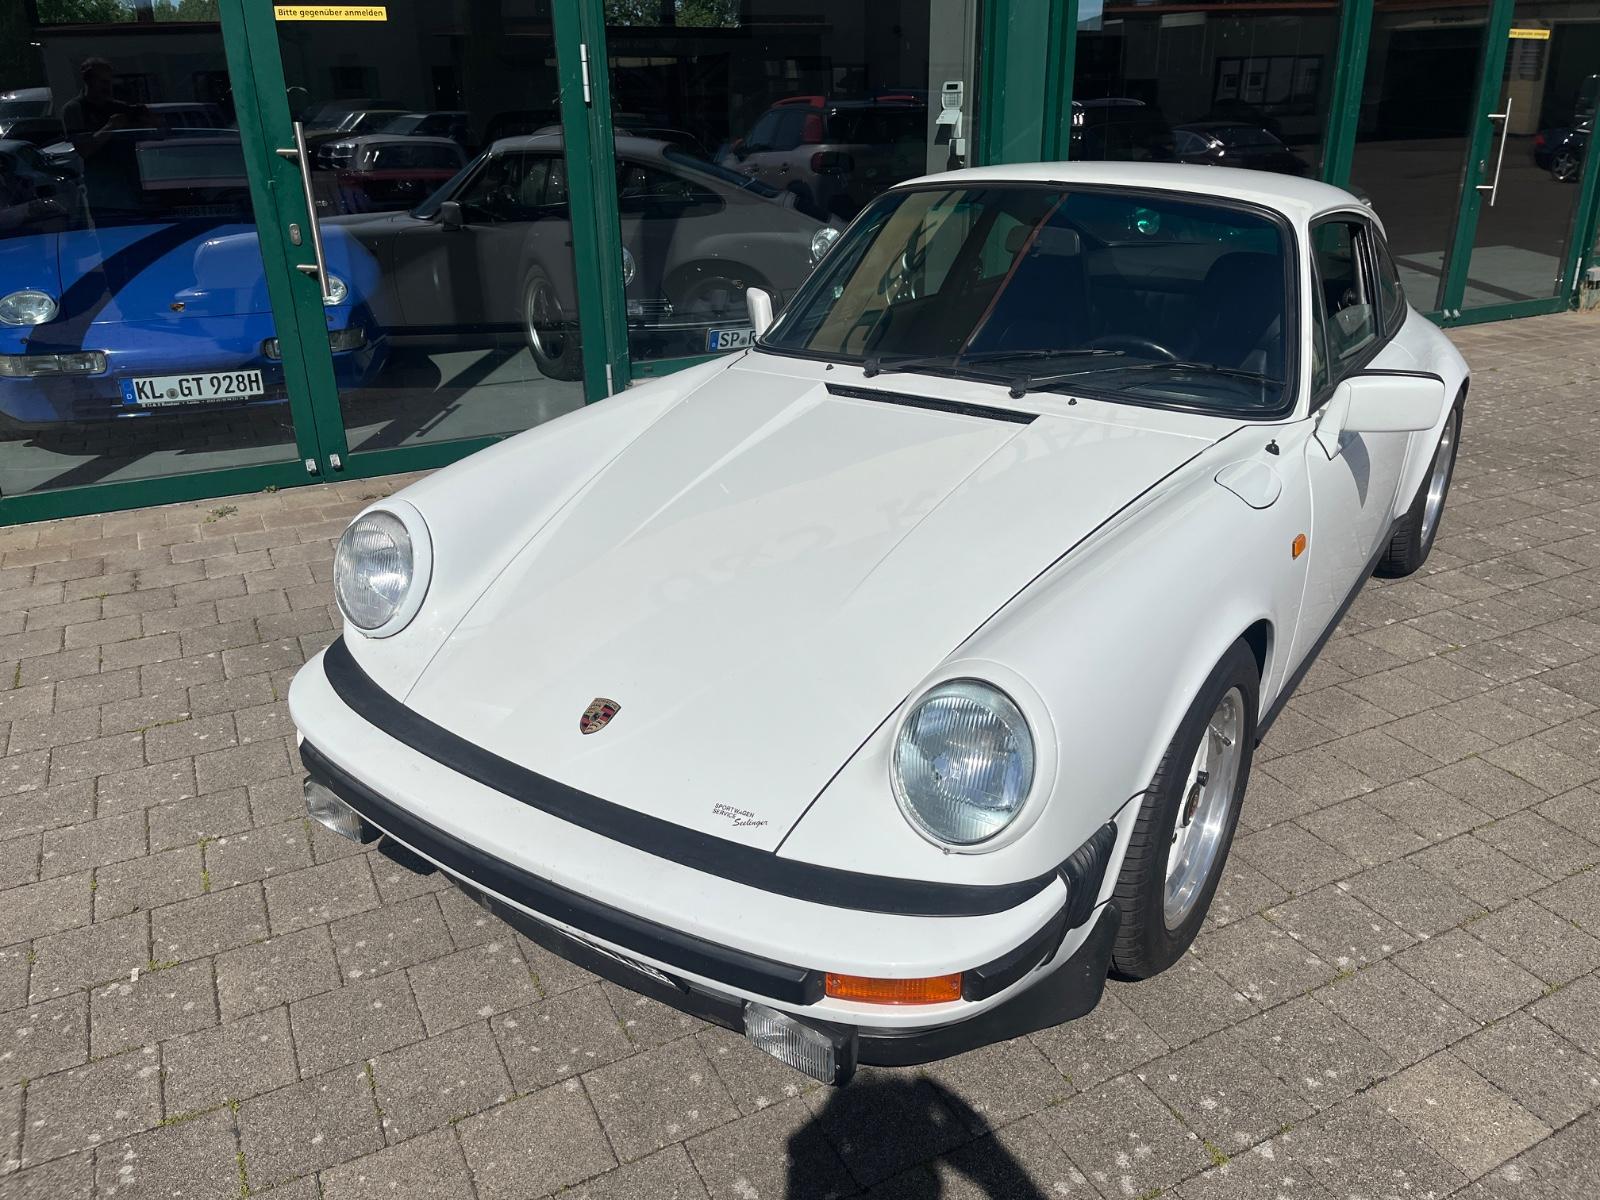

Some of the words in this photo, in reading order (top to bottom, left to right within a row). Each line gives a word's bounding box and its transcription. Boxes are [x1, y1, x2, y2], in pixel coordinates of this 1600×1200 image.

[278, 8, 298, 16] Bitte
[299, 8, 342, 18] gegenüber
[344, 9, 384, 17] anmelden
[719, 332, 740, 347] SP
[135, 379, 164, 400] KL
[178, 376, 203, 398] GT
[210, 372, 261, 395] 928H
[712, 808, 737, 819] SERVICE
